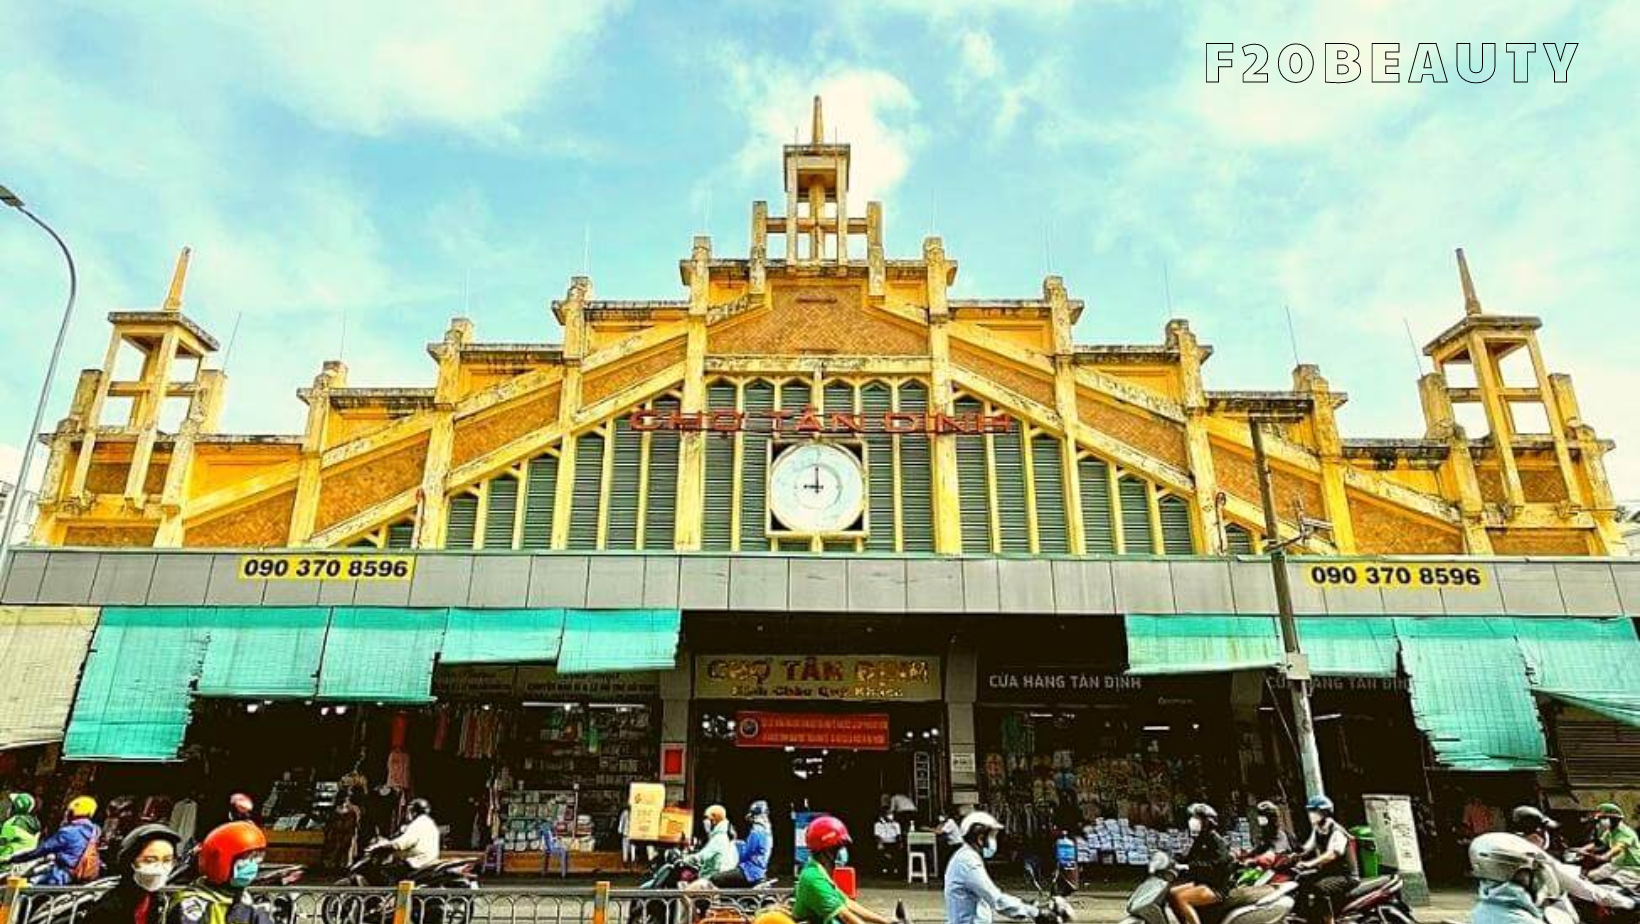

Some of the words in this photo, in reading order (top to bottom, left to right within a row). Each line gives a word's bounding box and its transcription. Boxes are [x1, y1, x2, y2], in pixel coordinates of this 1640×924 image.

[759, 403, 866, 432] TÂN
[244, 559, 289, 577] 090
[296, 559, 341, 577] 370
[348, 560, 408, 578] 8596
[1311, 566, 1357, 584] 090
[1366, 566, 1411, 585] 370
[1419, 567, 1481, 586] 8596
